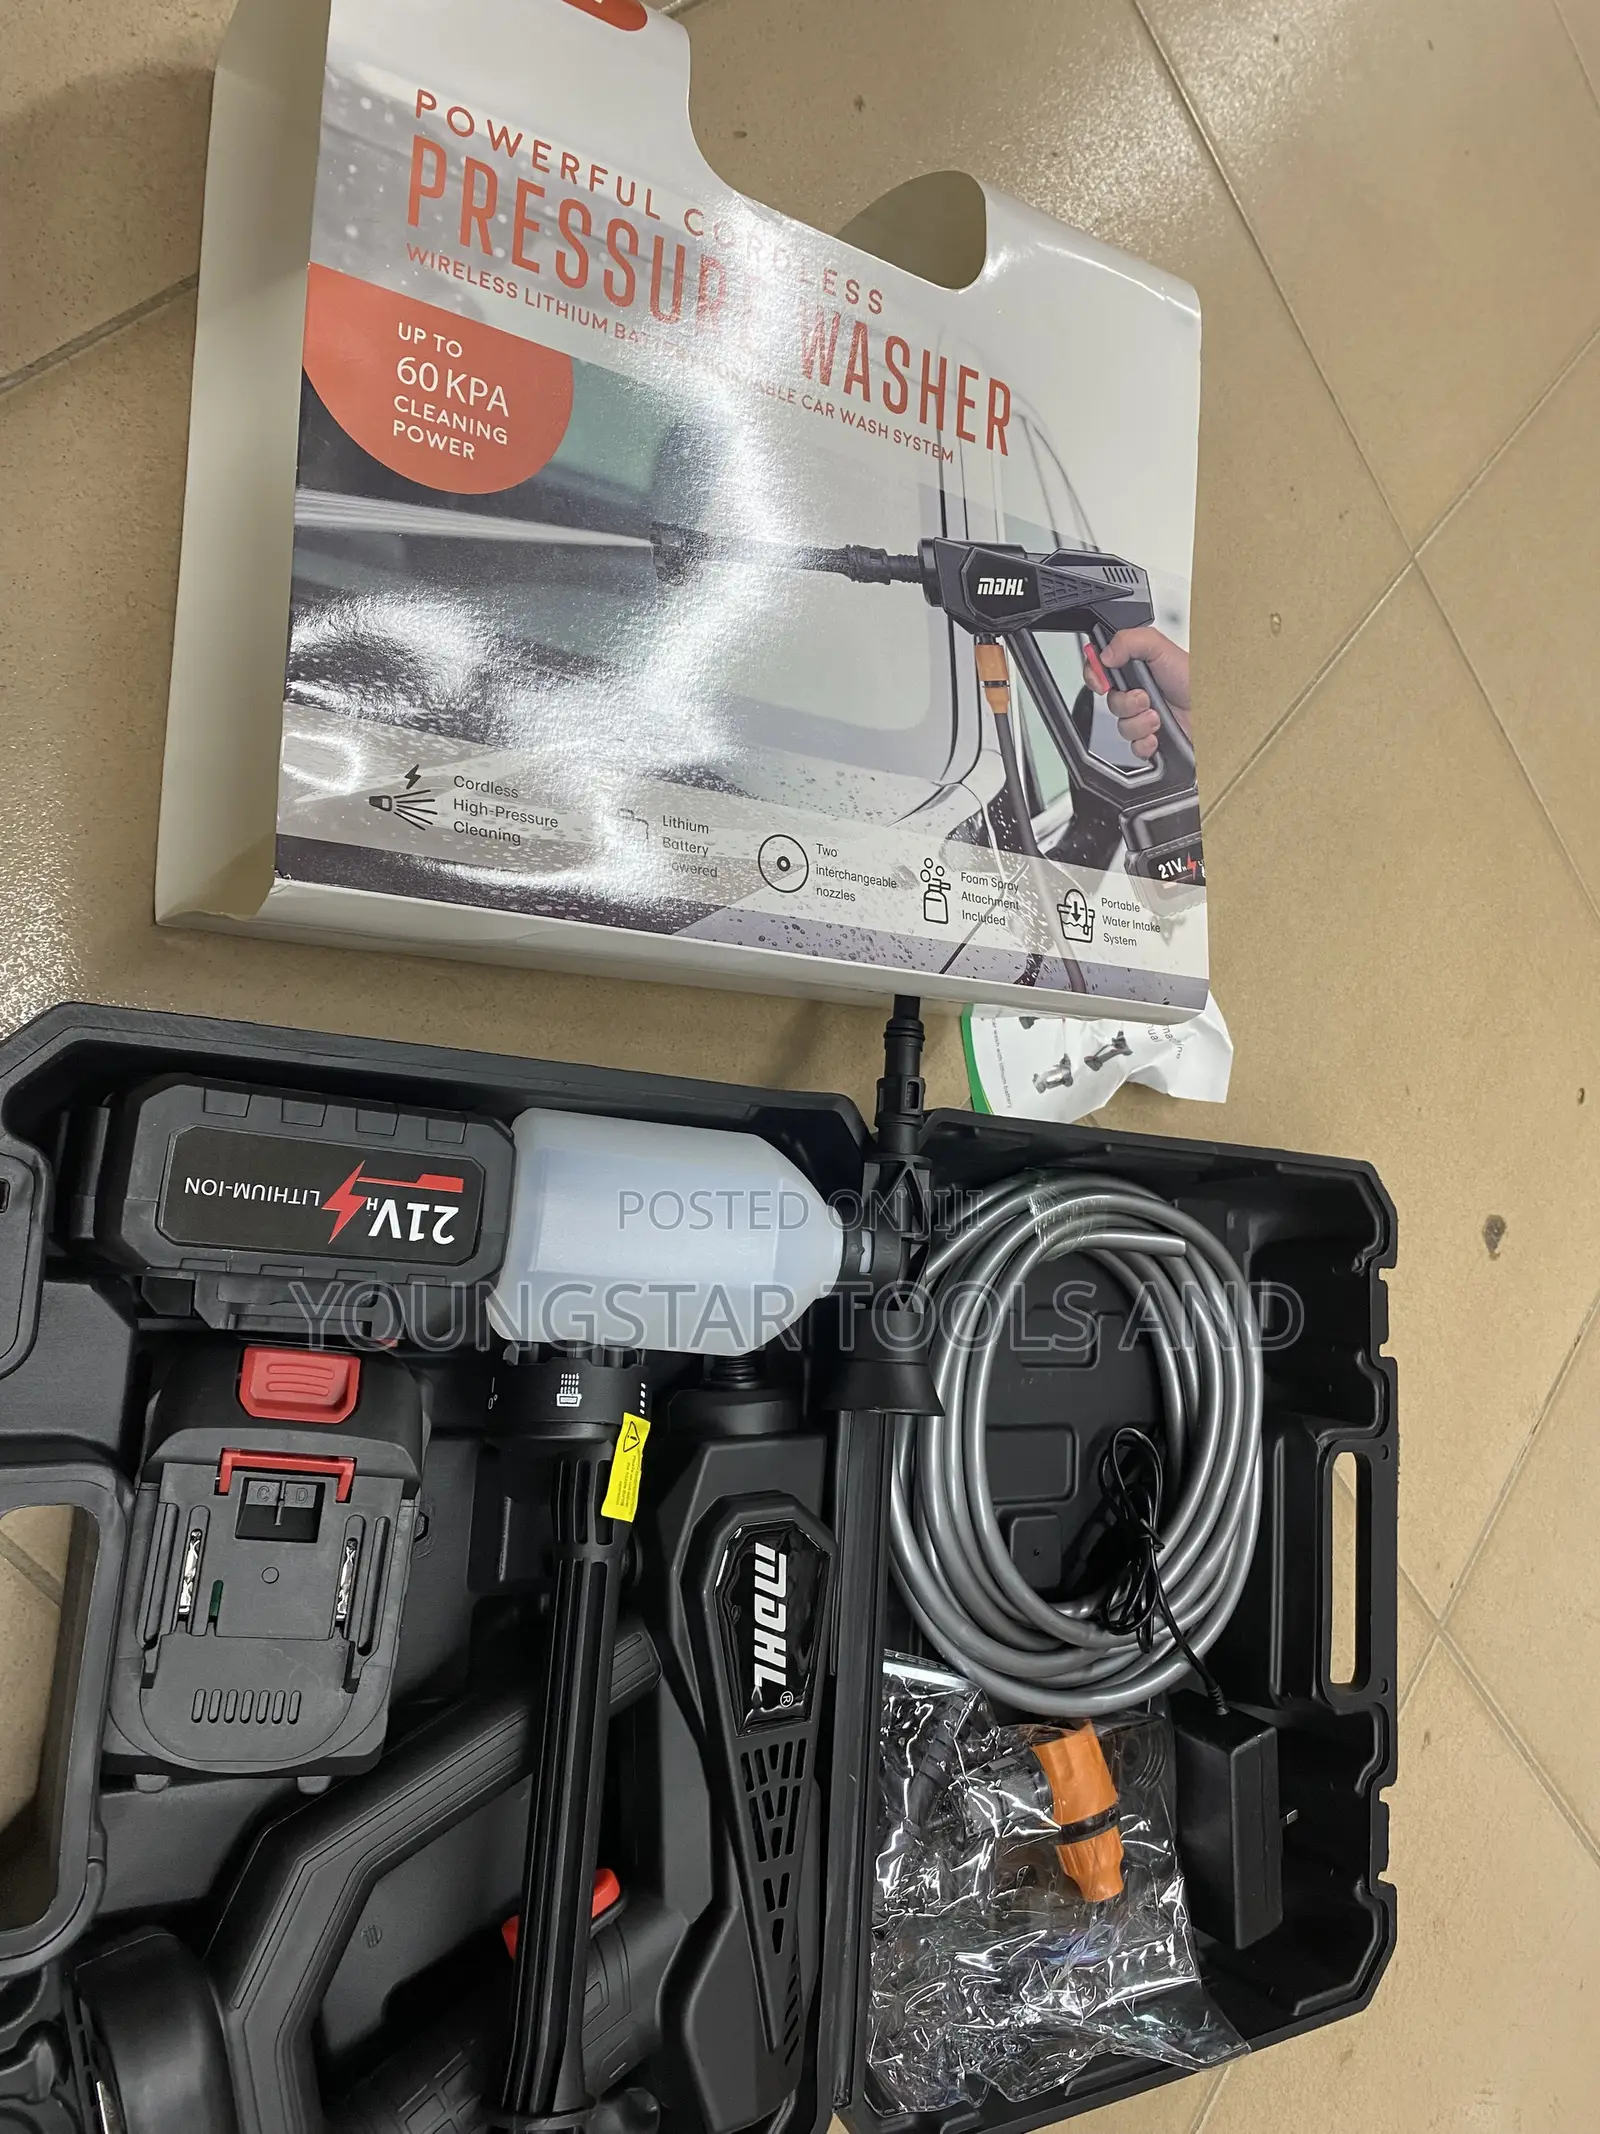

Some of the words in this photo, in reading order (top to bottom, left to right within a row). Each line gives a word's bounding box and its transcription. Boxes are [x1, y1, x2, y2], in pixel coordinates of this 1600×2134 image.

[415, 88, 661, 220] POWERFUL
[684, 208, 883, 315] COLESS
[407, 134, 762, 353] PRESSUR
[799, 300, 1011, 457] WASHER
[398, 321, 427, 345] UP
[433, 333, 463, 358] TO
[406, 242, 519, 299] WIRELESS
[525, 287, 608, 334] LITHIUM
[801, 394, 835, 420] CAR
[839, 407, 889, 440] WASH
[893, 428, 954, 464] SYSTEM
[396, 356, 439, 392] 60
[446, 368, 510, 417] KPA
[393, 395, 508, 445] CLEANING
[393, 419, 475, 461] POWER
[453, 775, 520, 799] Cordless
[453, 798, 559, 830] High-Pressure
[662, 815, 710, 835] Lithium
[453, 820, 522, 847] Cleaning
[662, 837, 709, 858] Battery
[816, 842, 838, 858] Two
[663, 859, 719, 880] owered
[815, 863, 898, 890] interchangeable
[816, 885, 856, 902] nozzles
[960, 871, 989, 887] Foam
[991, 876, 1020, 893] Spray
[961, 891, 1020, 910] Attachment
[1101, 898, 1141, 913] Portable
[961, 908, 1006, 927] Included
[1102, 916, 1130, 930] Water
[1132, 920, 1161, 933] Intake
[1103, 933, 1138, 948] System
[184, 1175, 320, 1206] LITHIUM-ION
[257, 1485, 270, 1503] C
[296, 1487, 308, 1504] D
